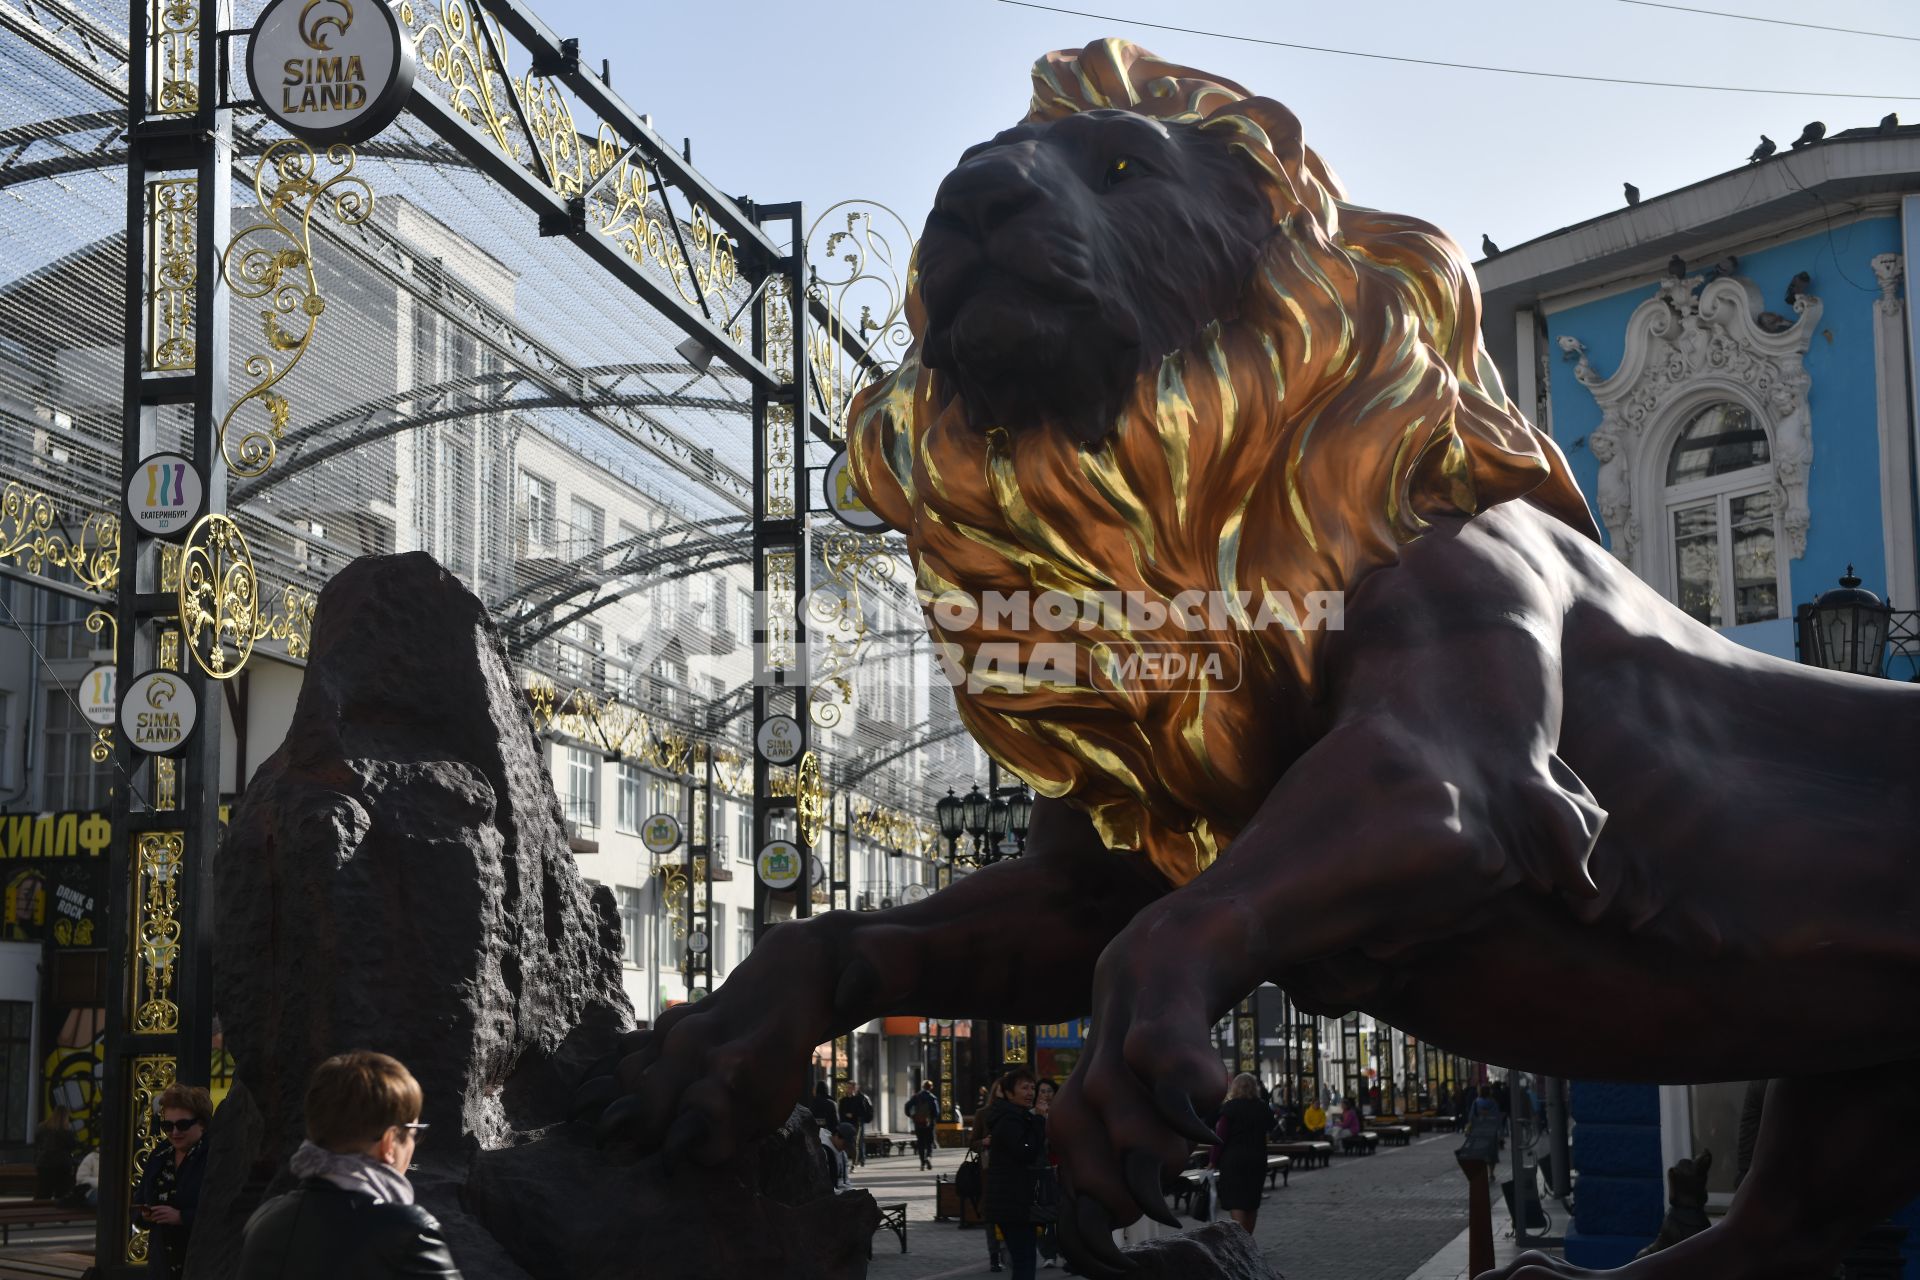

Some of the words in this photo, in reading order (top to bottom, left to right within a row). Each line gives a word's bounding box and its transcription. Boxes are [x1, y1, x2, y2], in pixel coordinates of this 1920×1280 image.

[282, 55, 366, 86] SIMA
[282, 82, 367, 113] LAND
[140, 510, 188, 519] ЕКАТЕРИНБУРГ
[136, 712, 181, 728] SIMA
[135, 728, 182, 743] LAND
[767, 739, 793, 749] SIMA
[767, 749, 793, 757] LAND
[56, 884, 86, 907] DRINK
[57, 899, 85, 920] ROCK
